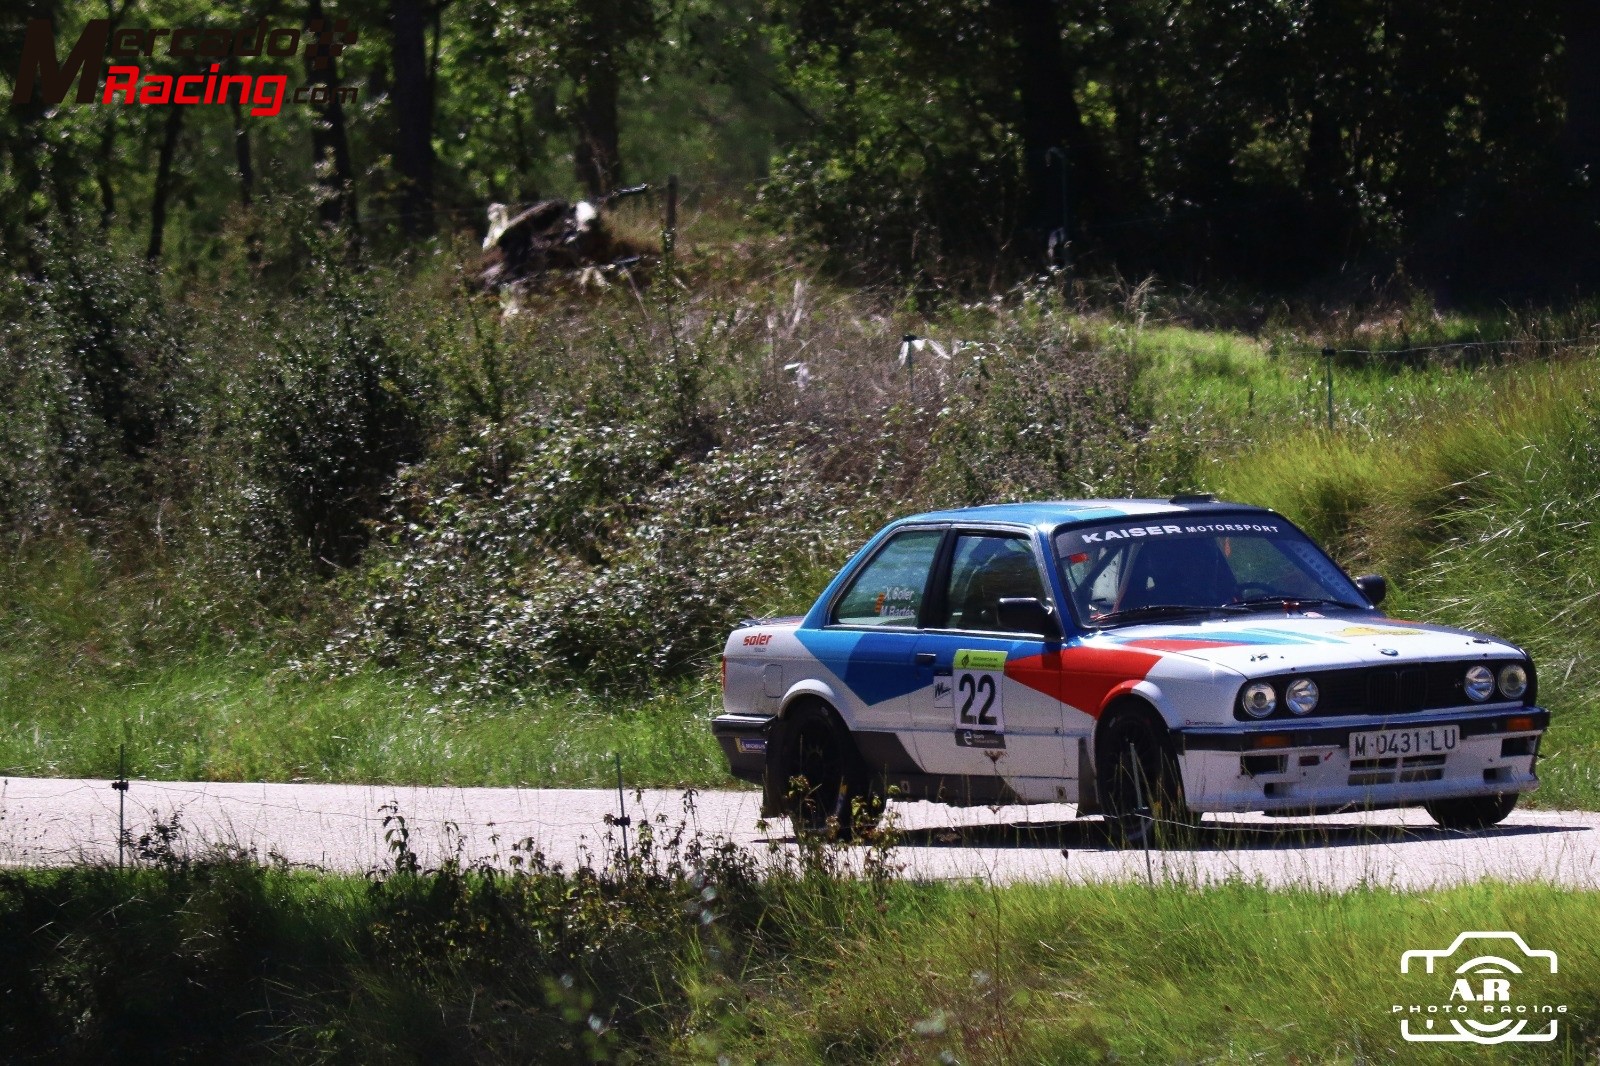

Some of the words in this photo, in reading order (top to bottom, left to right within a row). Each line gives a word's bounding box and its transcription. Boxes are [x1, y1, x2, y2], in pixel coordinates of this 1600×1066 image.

[1081, 525, 1183, 544] KAISER
[1185, 524, 1279, 533] MOTORSPORT
[742, 632, 773, 646] soler
[959, 673, 997, 725] 22
